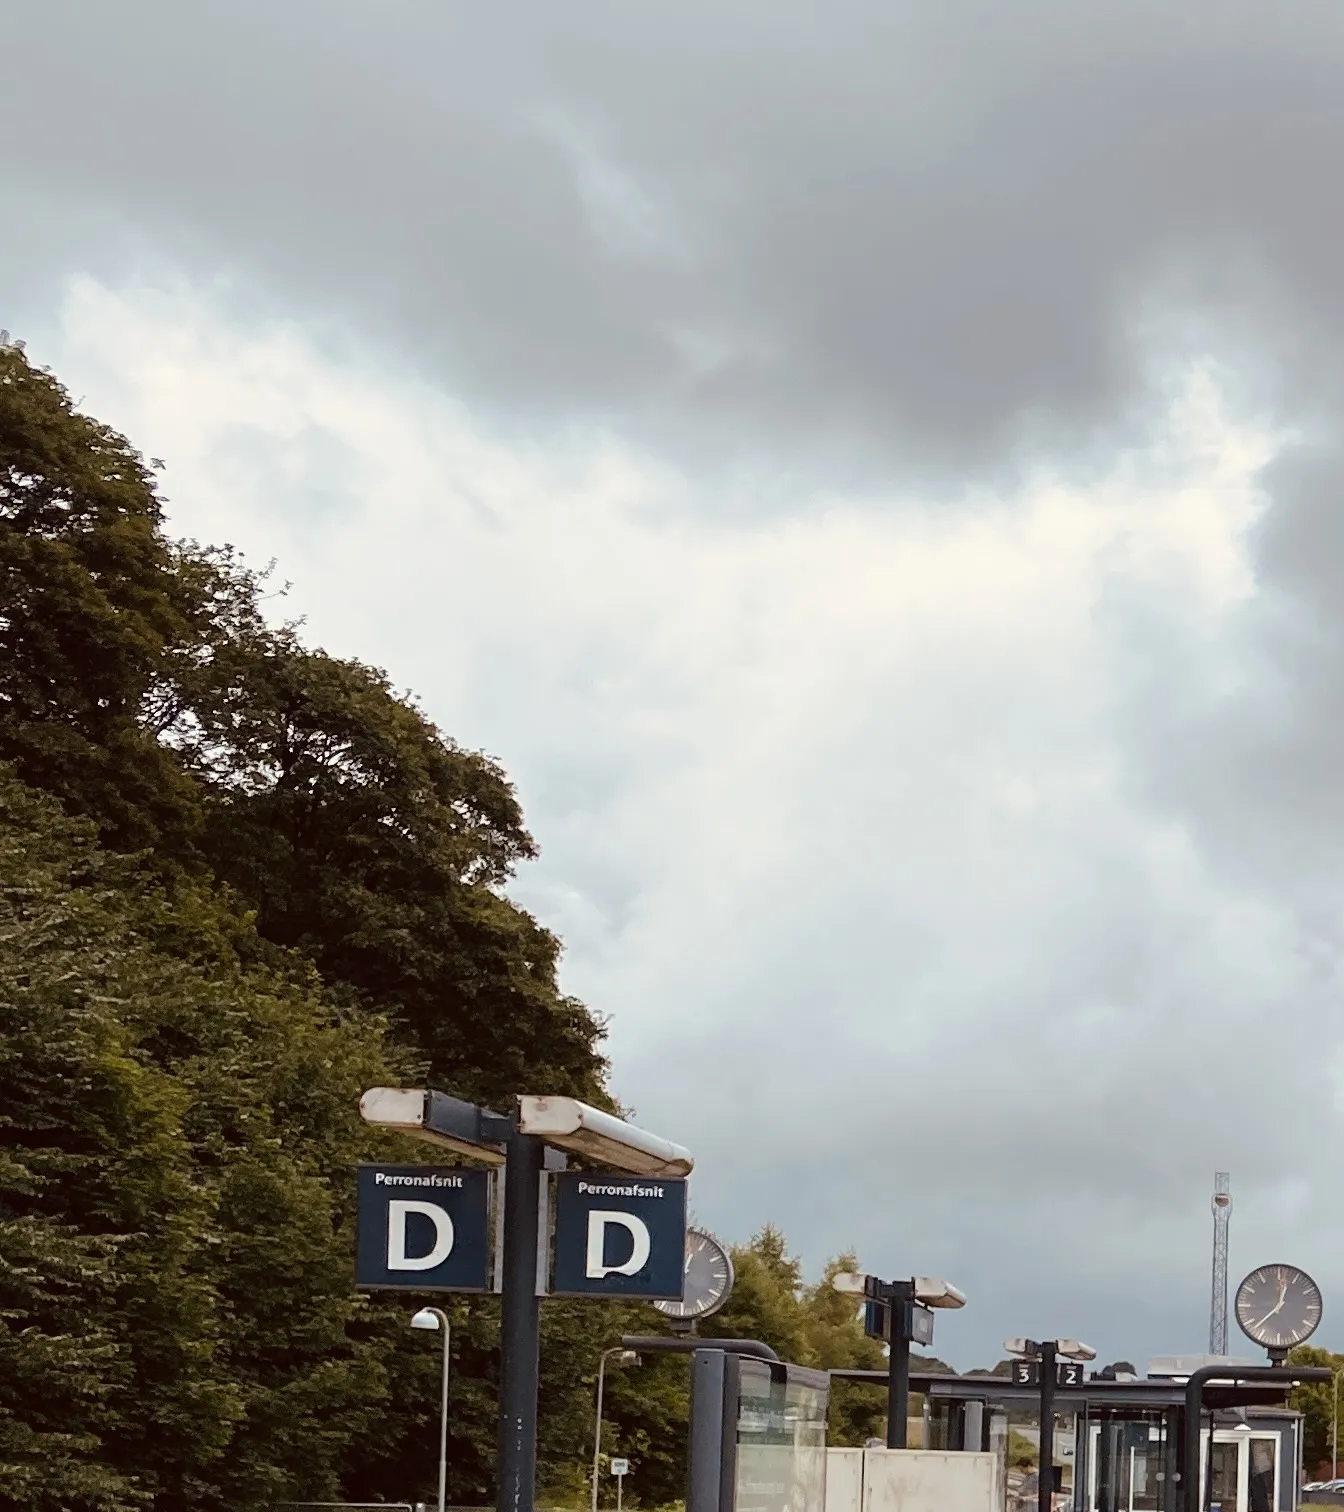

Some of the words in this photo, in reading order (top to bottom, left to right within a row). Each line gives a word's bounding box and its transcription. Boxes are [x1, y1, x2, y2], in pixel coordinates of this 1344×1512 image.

[375, 1172, 463, 1188] Perronafsnit
[578, 1181, 664, 1198] Perronafsnit
[387, 1199, 454, 1271] D
[586, 1210, 651, 1279] D
[1018, 1368, 1030, 1383] 3
[1065, 1370, 1077, 1385] 2
